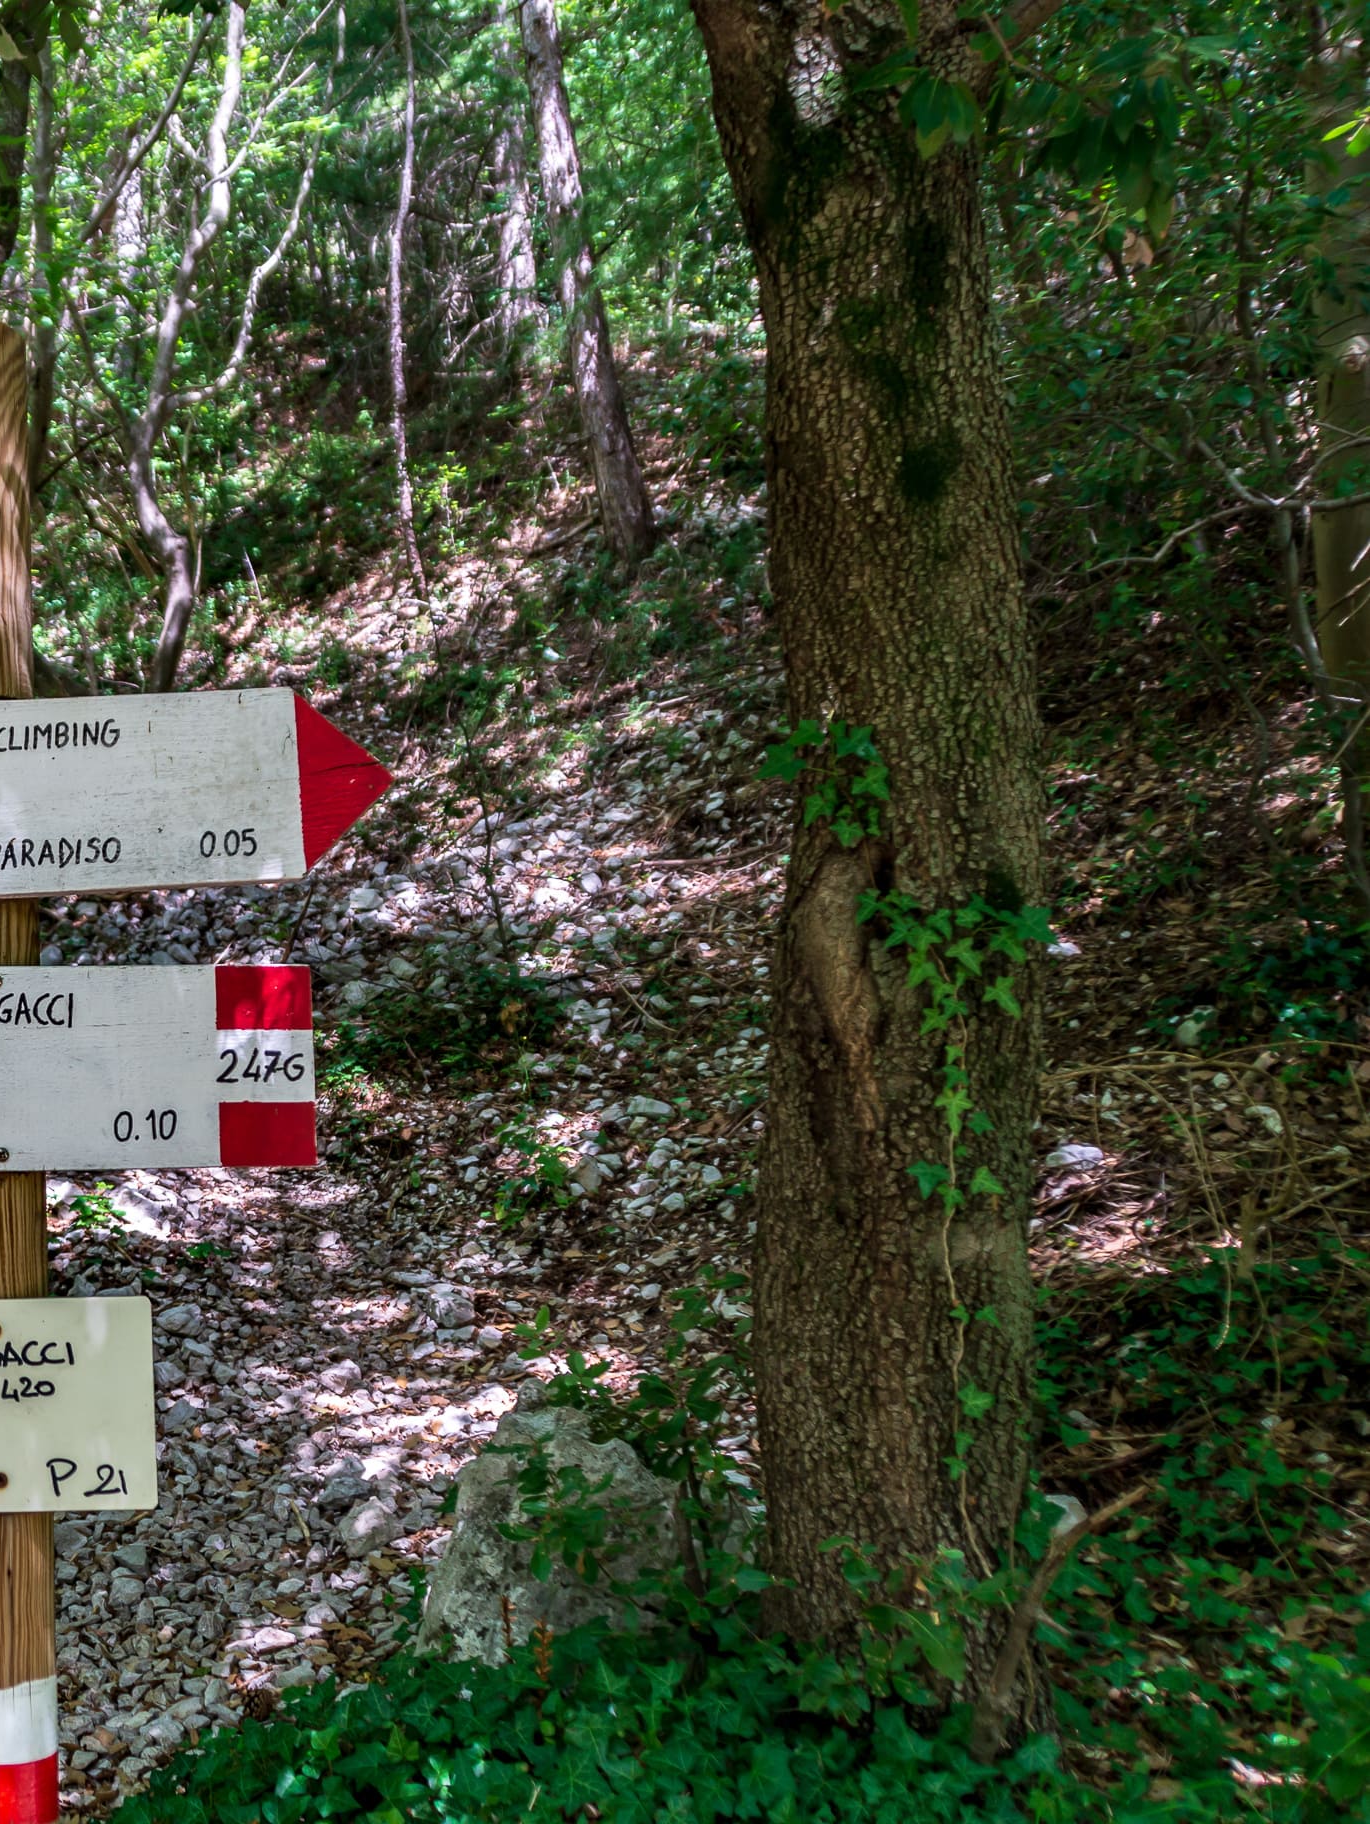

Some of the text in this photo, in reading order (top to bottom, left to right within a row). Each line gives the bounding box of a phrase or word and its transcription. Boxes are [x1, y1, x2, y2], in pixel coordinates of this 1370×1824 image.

[200, 828, 259, 859] 0.05
[216, 1048, 305, 1084] 247G
[113, 1109, 178, 1143] 0.10
[1, 1377, 56, 1402] 420
[46, 1458, 128, 1497] P 21
